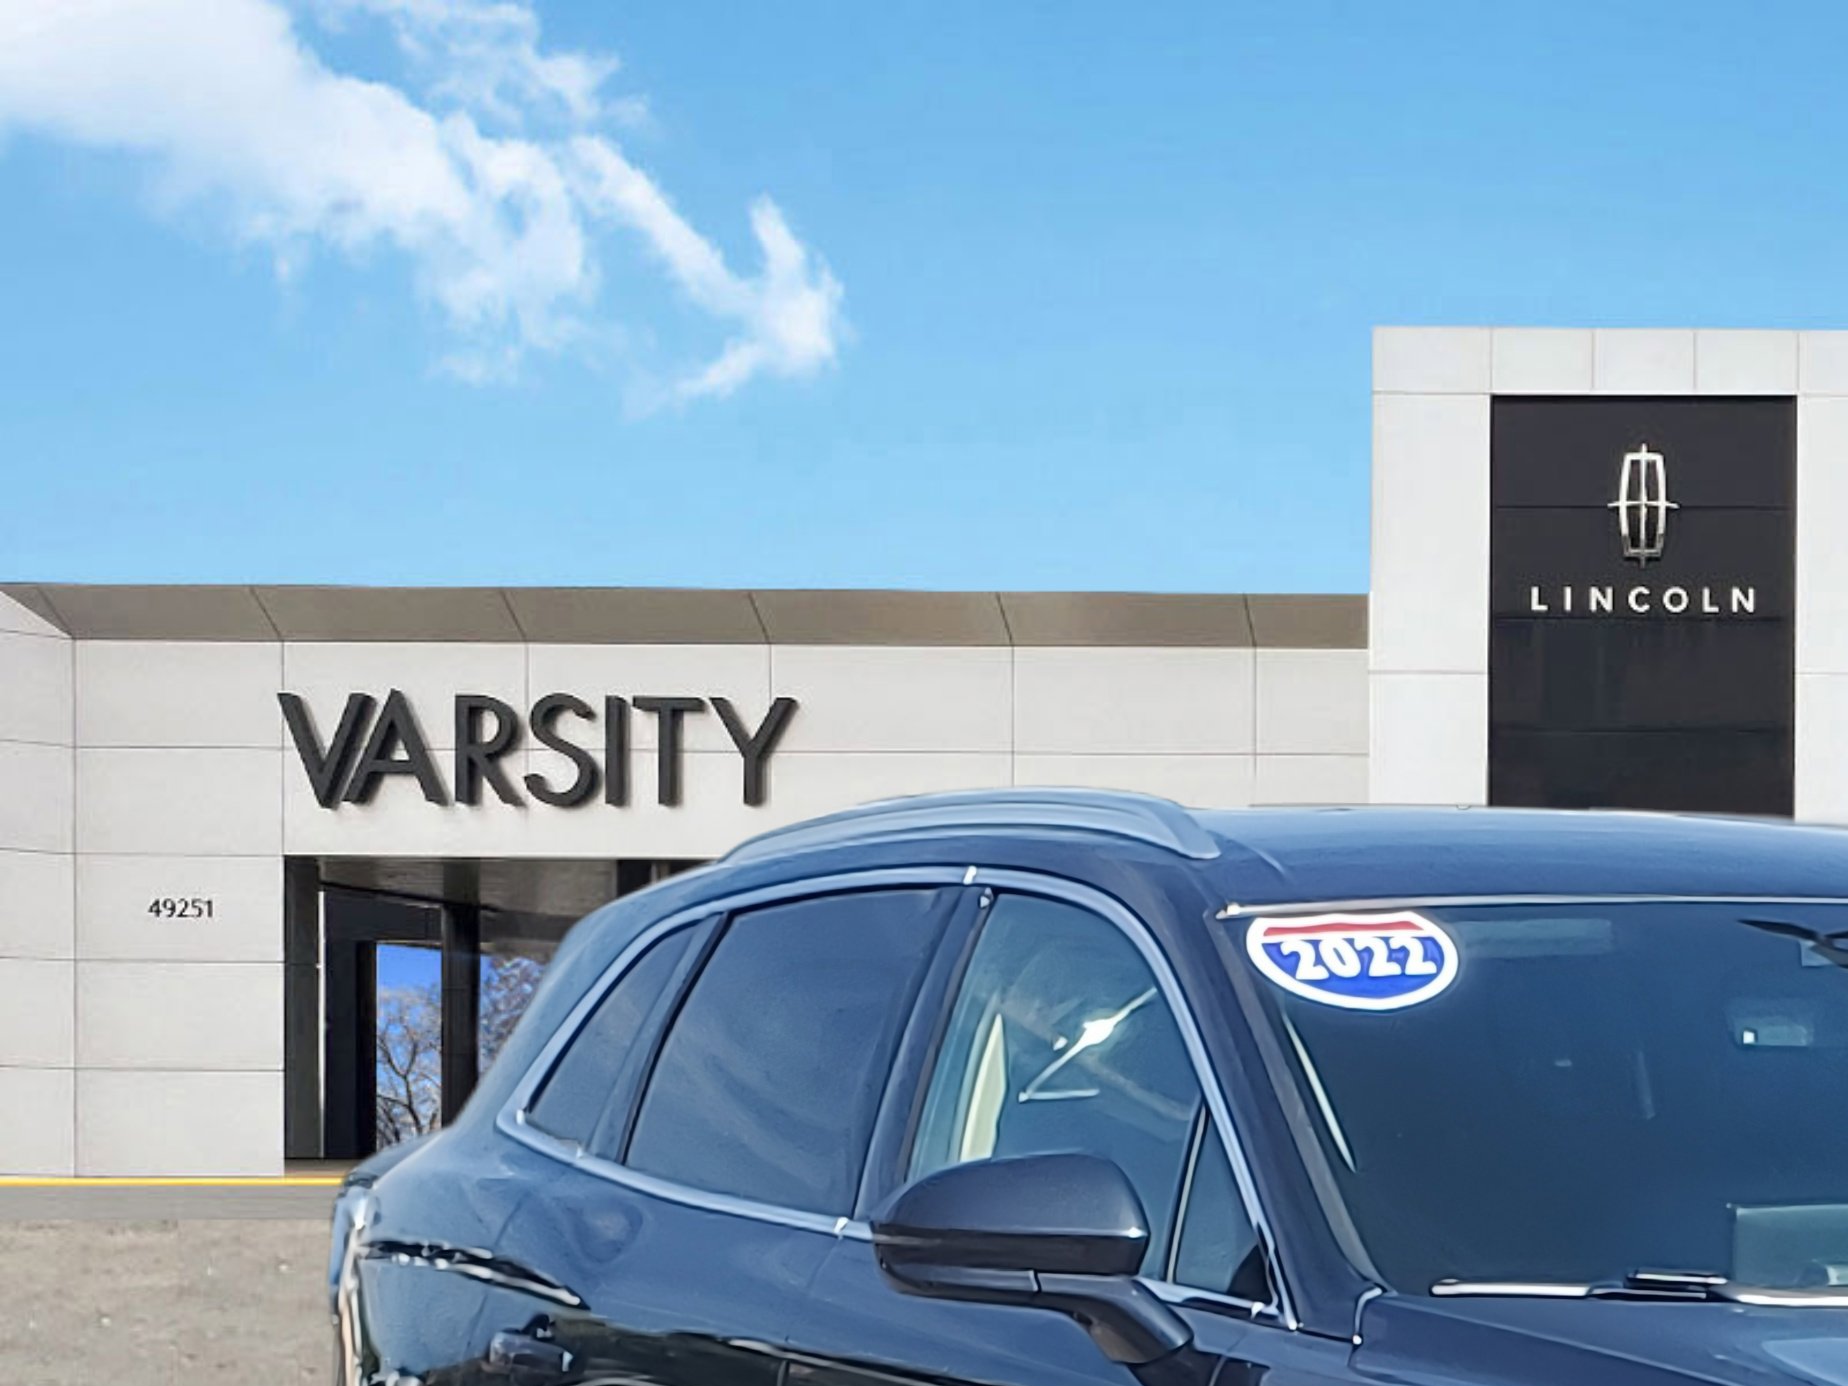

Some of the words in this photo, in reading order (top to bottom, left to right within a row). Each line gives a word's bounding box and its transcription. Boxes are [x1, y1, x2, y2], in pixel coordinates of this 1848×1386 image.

[1531, 586, 1754, 612] LINCOLN
[277, 689, 798, 810] VARSITY
[148, 898, 213, 918] 49251
[1280, 936, 1438, 980] 2022
